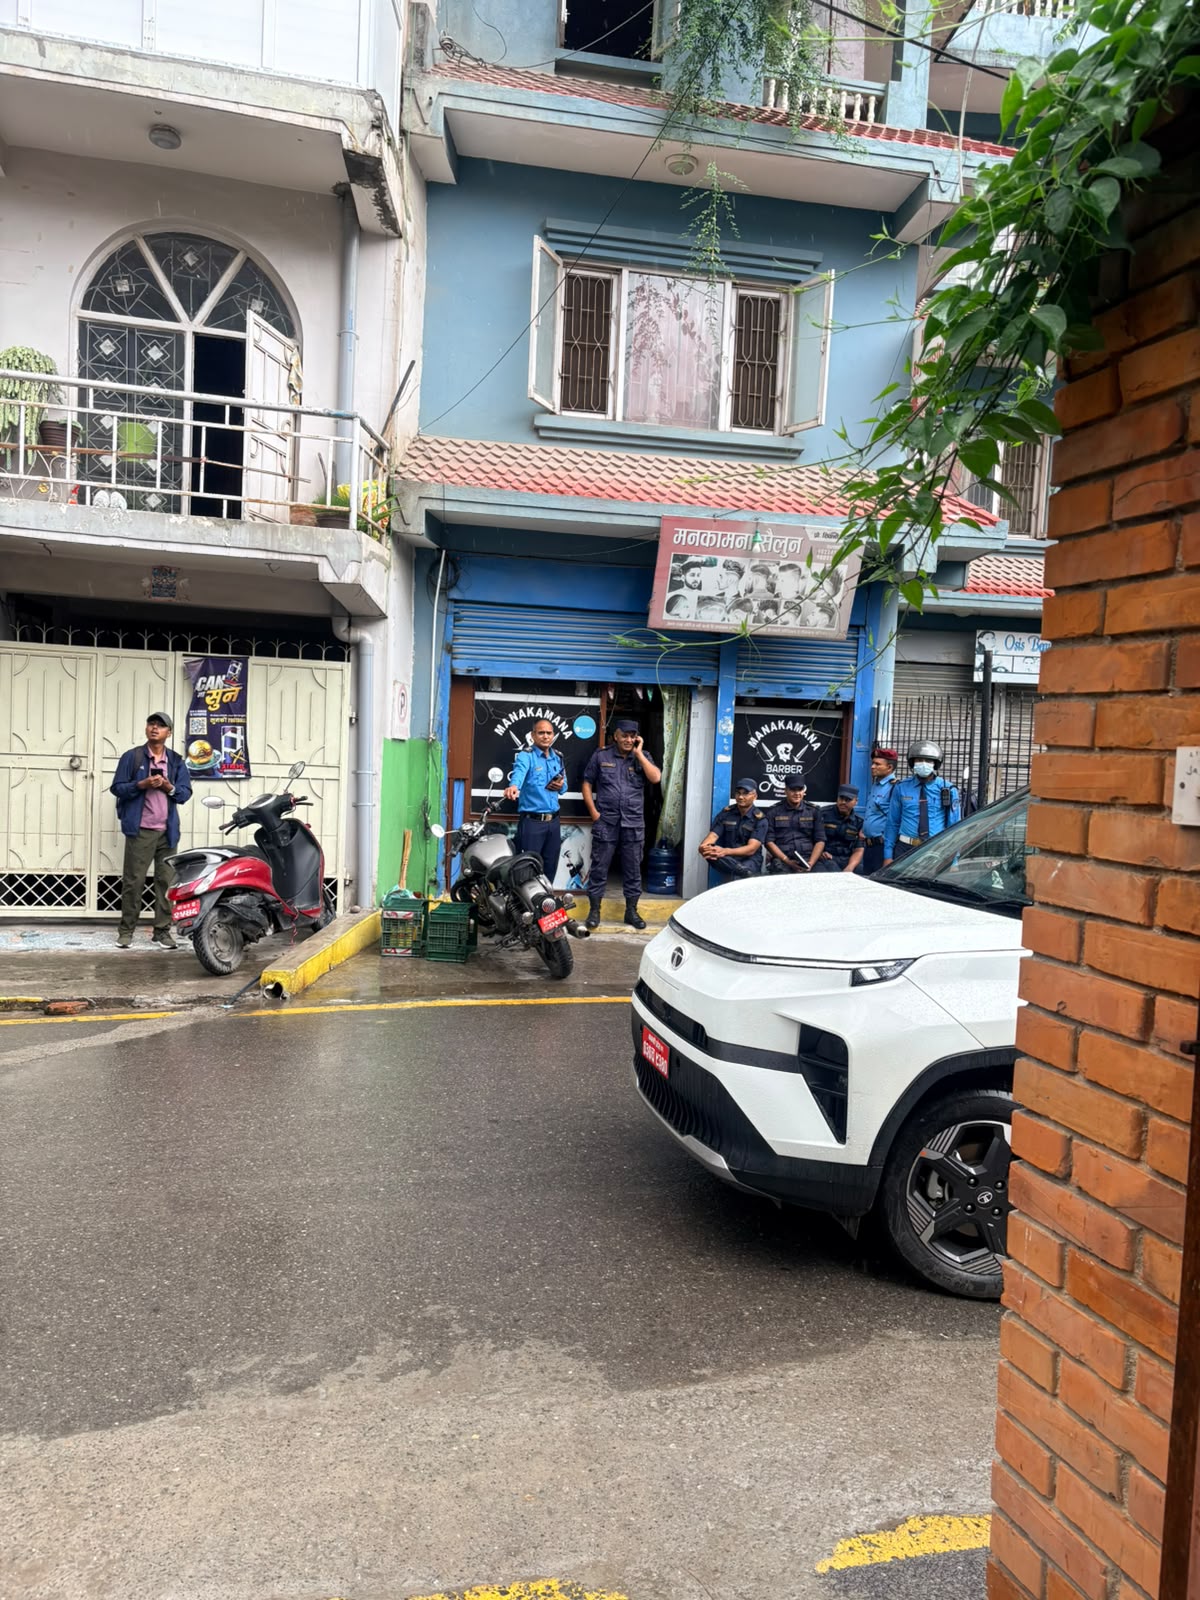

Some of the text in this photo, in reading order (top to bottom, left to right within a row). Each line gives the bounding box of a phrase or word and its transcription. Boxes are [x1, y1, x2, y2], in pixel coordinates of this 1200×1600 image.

[673, 528, 754, 551] मनकामना
[195, 675, 226, 691] CAN
[205, 687, 242, 712] सुन
[494, 707, 573, 740] MANAKAMANA
[747, 720, 821, 751] MANAKAMANA
[766, 764, 803, 774] BARBER
